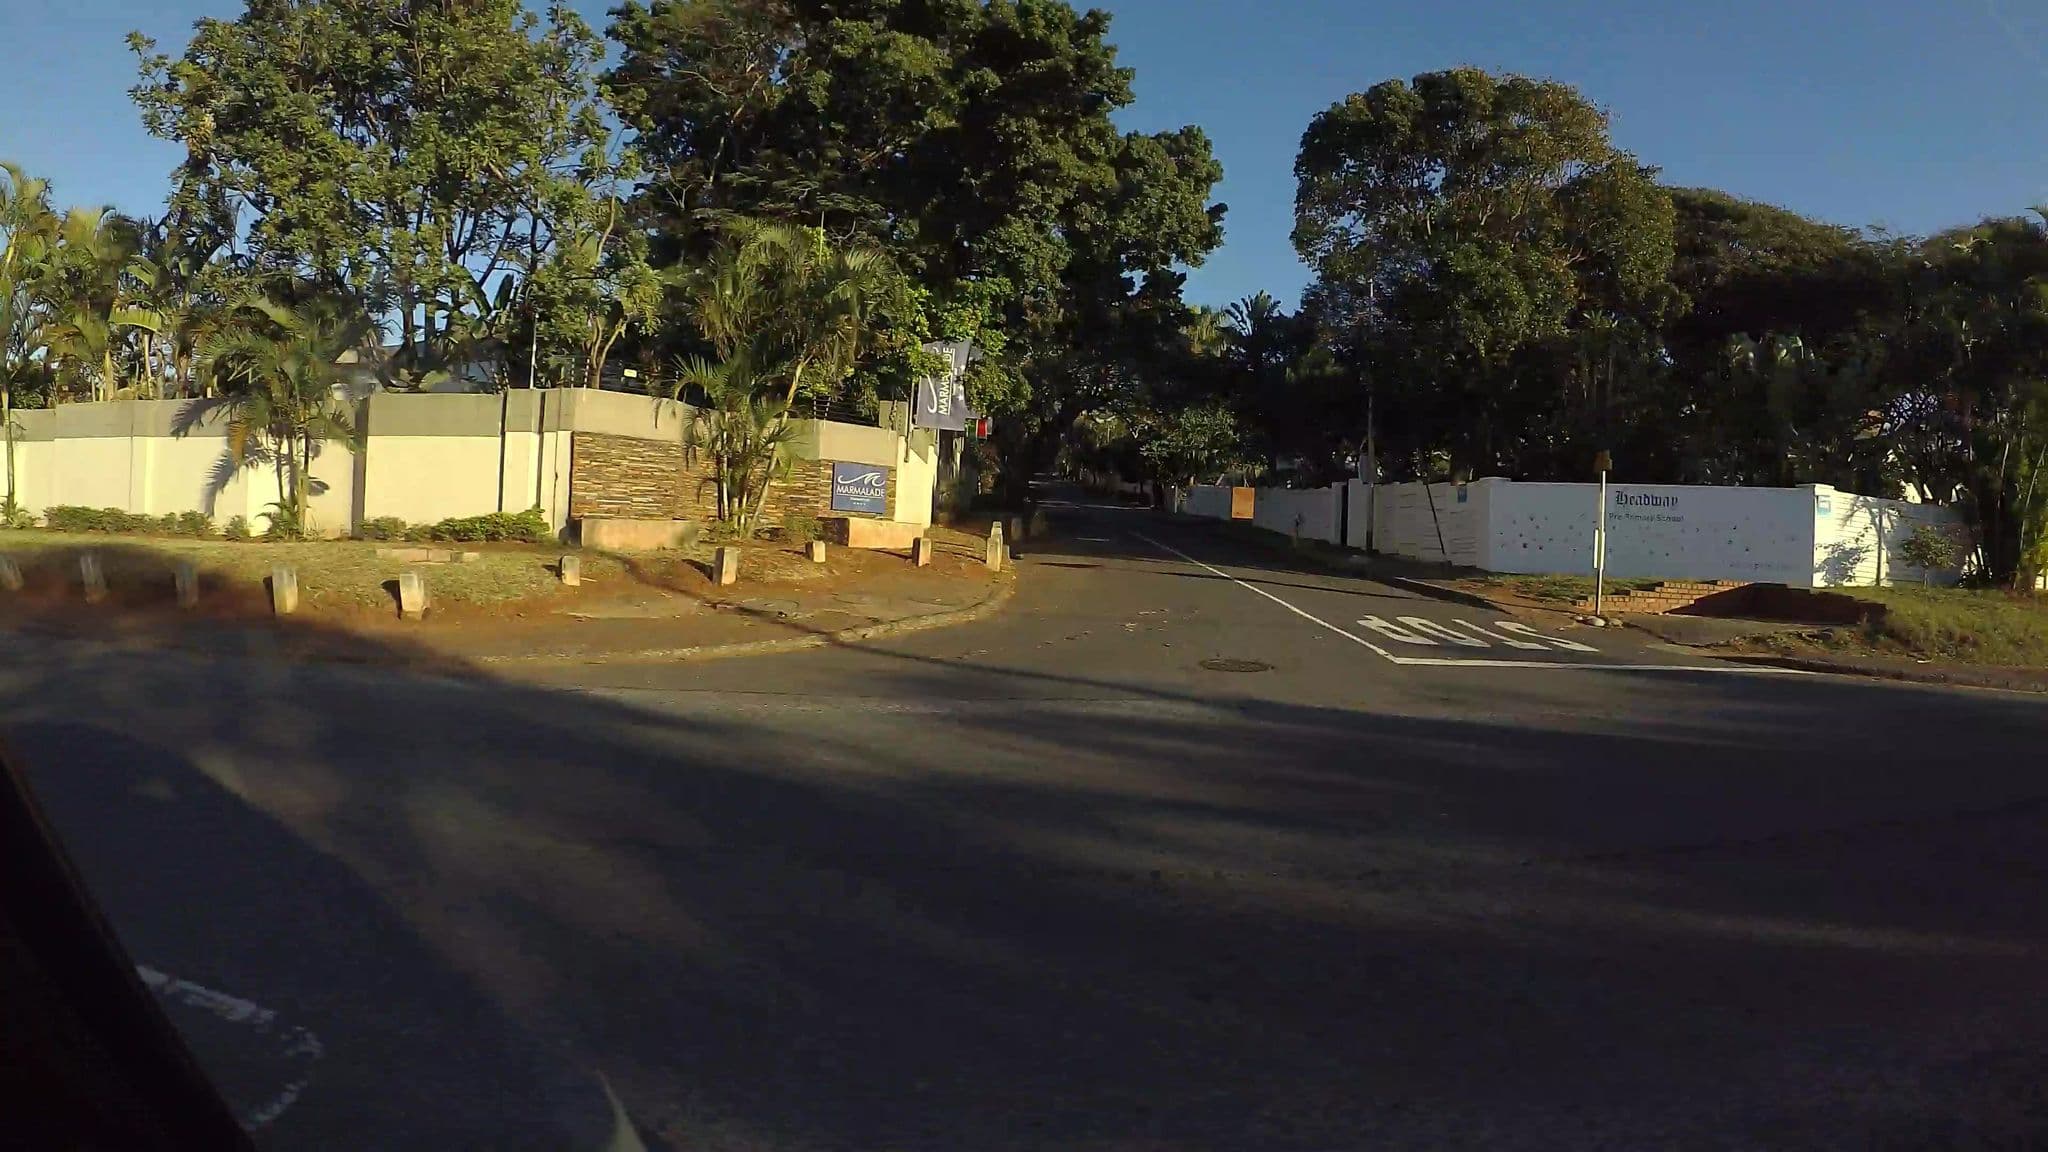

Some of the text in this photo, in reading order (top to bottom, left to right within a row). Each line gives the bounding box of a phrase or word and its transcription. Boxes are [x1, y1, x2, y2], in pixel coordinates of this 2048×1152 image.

[938, 347, 953, 416] MARMALDE
[836, 485, 886, 497] MARMALADE
[1616, 490, 1678, 507] Headway
[1356, 614, 1600, 652] STOP
